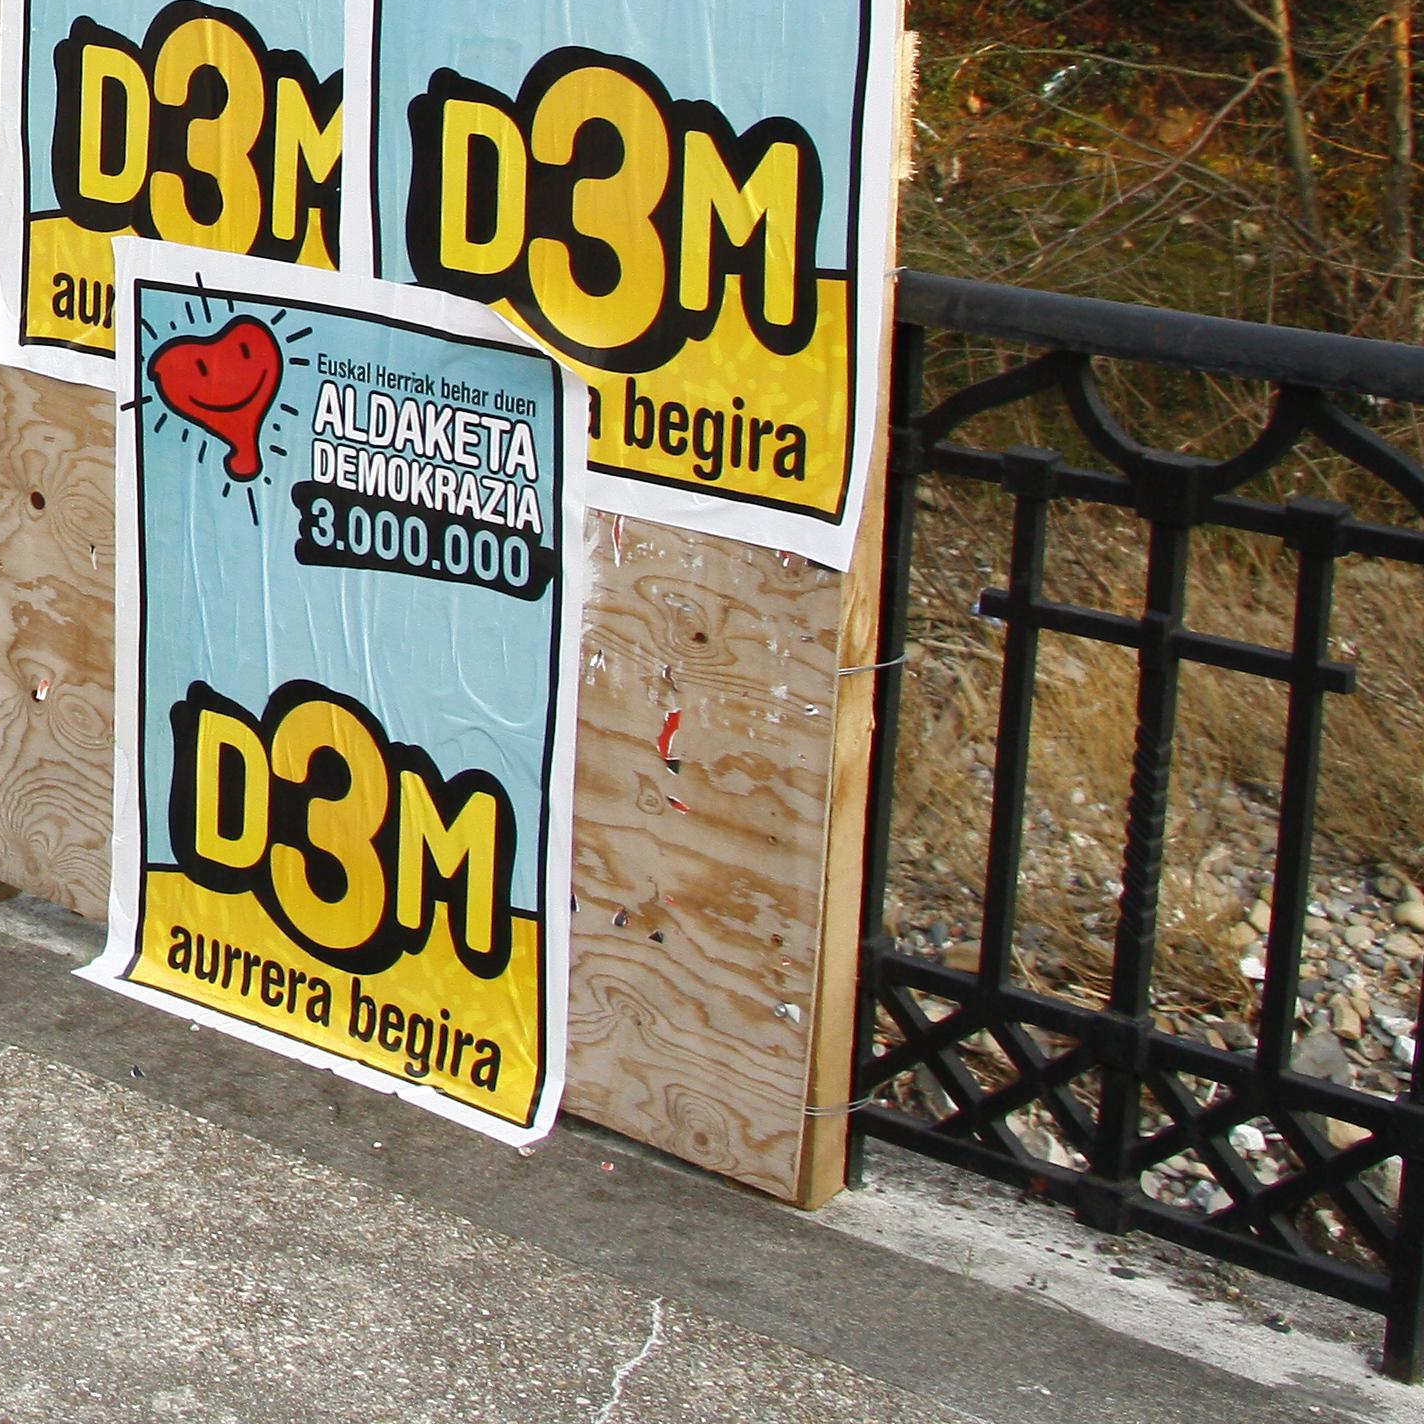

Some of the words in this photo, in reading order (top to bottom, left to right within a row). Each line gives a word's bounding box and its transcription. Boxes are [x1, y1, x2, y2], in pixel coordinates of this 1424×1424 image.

[79, 17, 344, 256] D3M
[440, 66, 799, 349] D3M
[313, 382, 538, 480] ALDAKETA
[317, 353, 371, 387] Euskal
[376, 364, 436, 397] Herriak
[441, 374, 489, 407] behar
[494, 389, 536, 418] duen
[625, 377, 806, 482] begira
[313, 441, 542, 535] DEMOKRAZIA
[310, 497, 531, 588] 3.000.000
[195, 699, 497, 955] D3M
[167, 924, 331, 1027] aurrera
[348, 976, 502, 1093] begira
